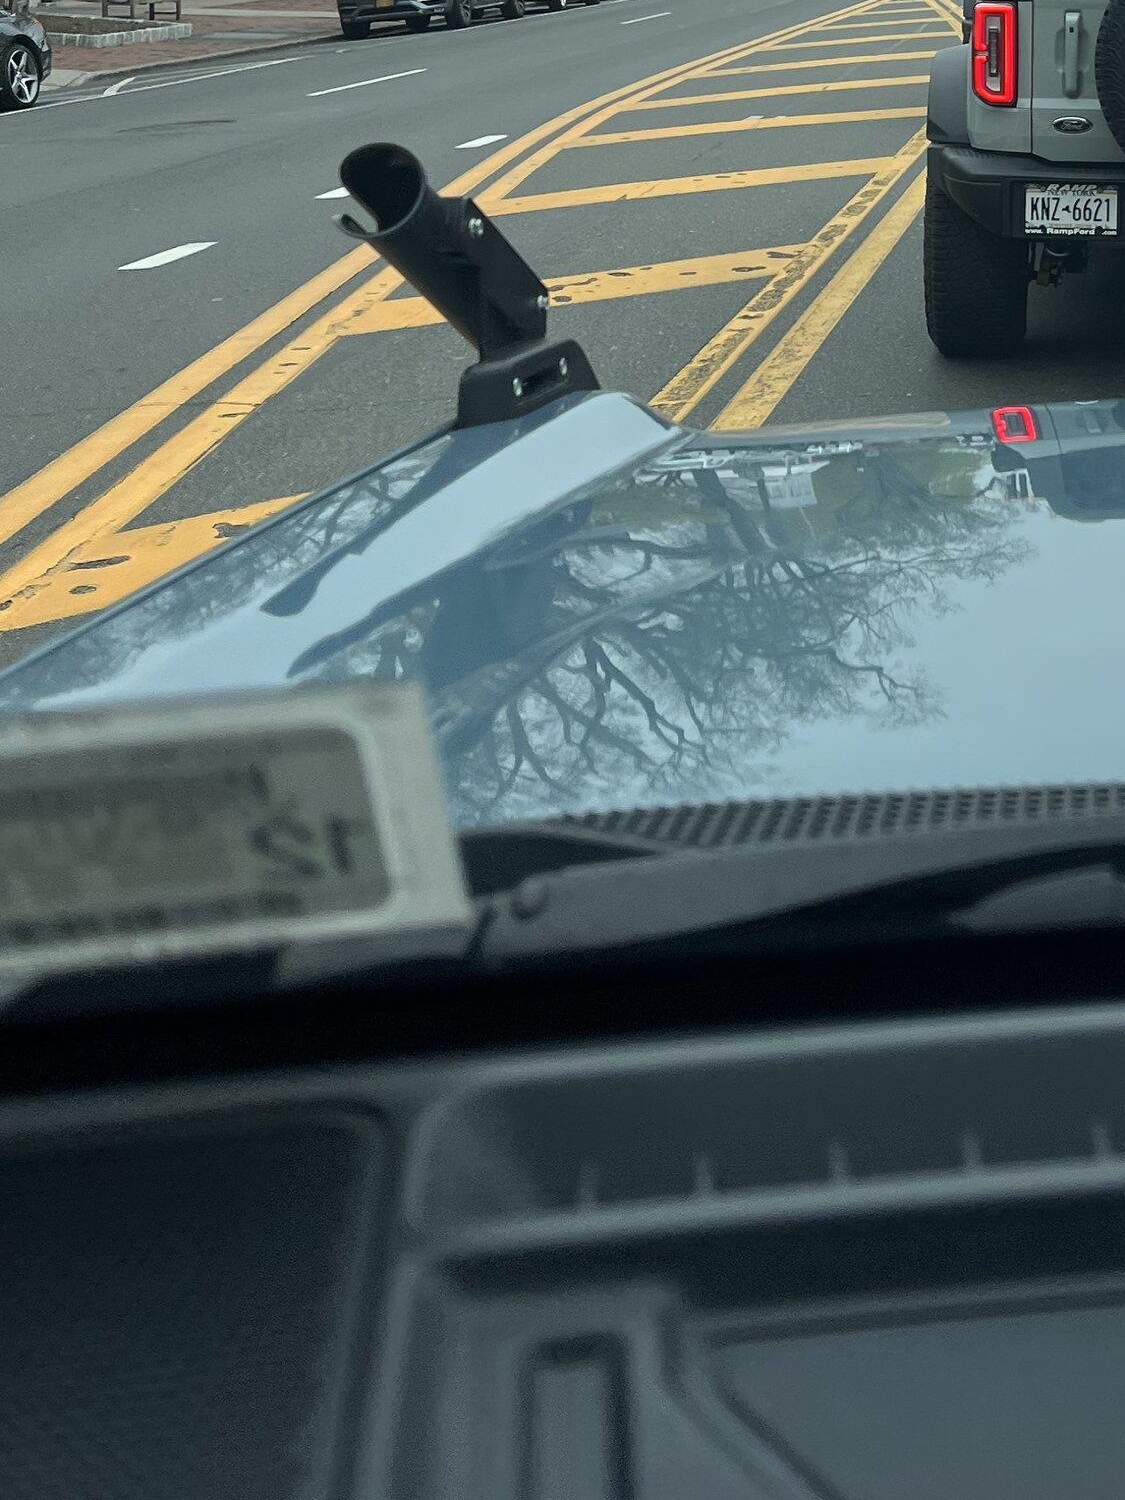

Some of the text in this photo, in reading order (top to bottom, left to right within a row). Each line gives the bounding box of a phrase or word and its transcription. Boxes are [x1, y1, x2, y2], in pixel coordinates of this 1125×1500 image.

[1030, 197, 1110, 222] KNZ 6621
[1046, 227, 1095, 235] RampFord
